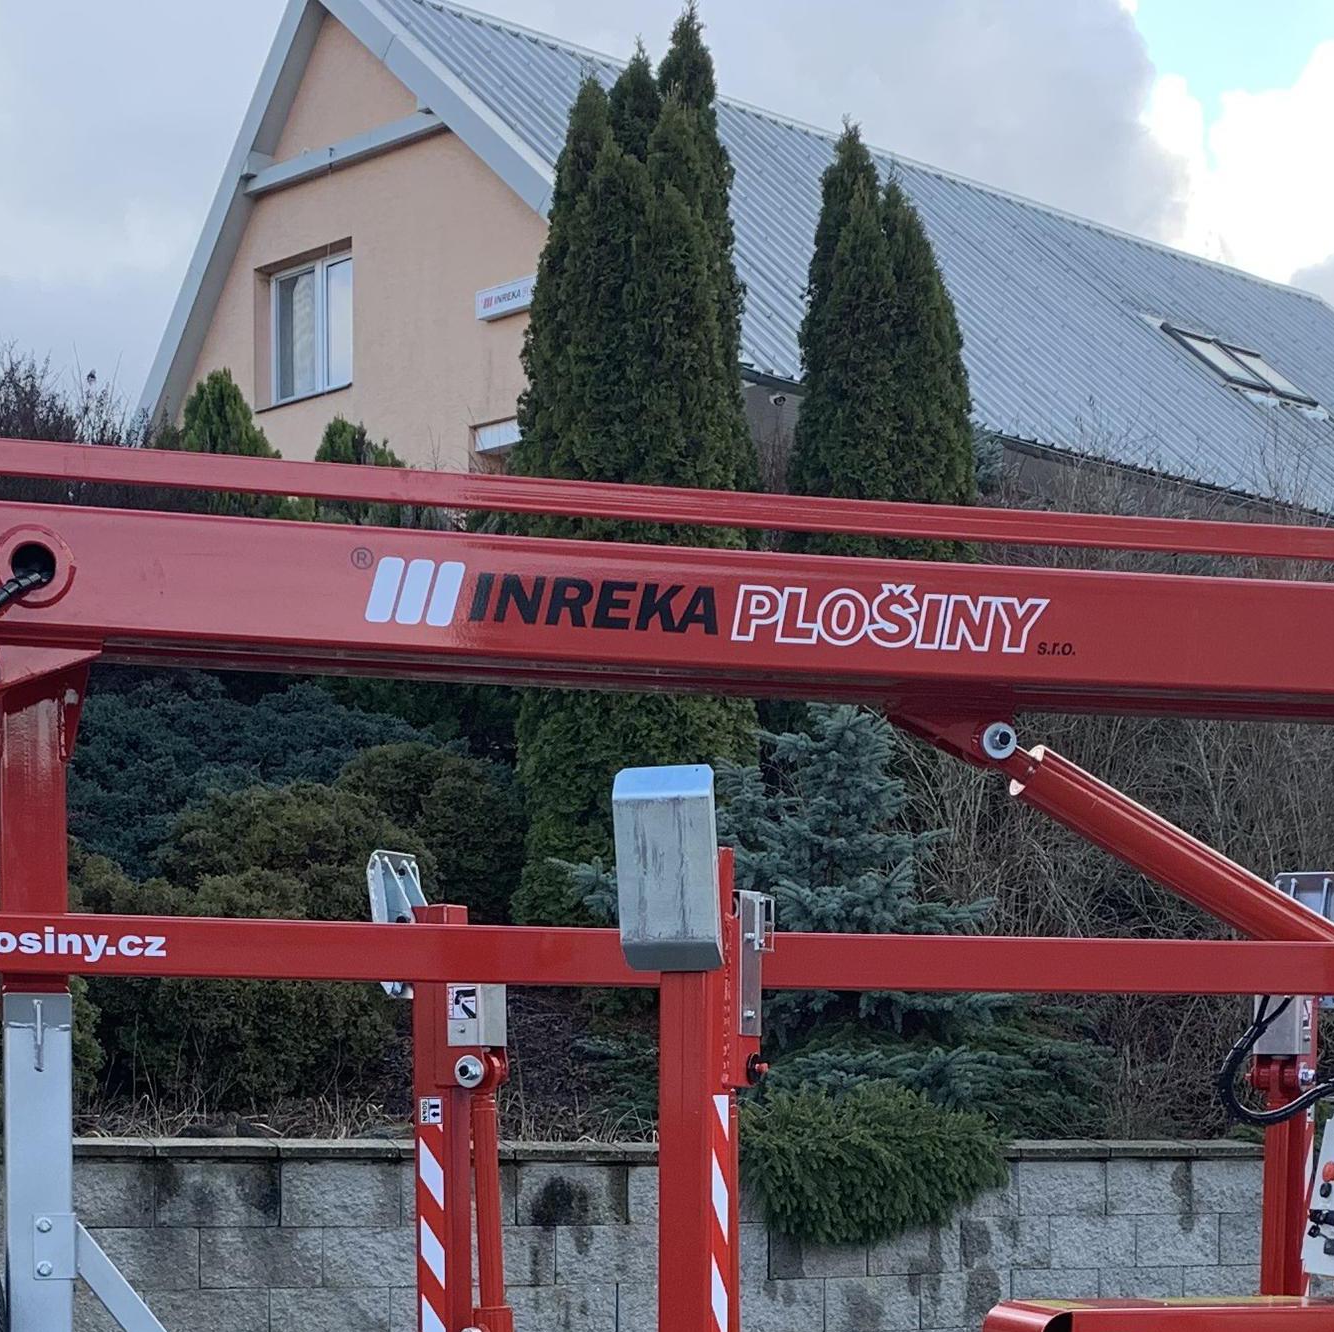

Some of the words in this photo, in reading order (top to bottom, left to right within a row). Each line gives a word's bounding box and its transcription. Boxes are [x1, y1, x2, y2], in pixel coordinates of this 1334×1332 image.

[468, 572, 719, 635] INREKA
[731, 583, 1051, 653] PLOŠINY
[1036, 641, 1077, 656] s.r.o.
